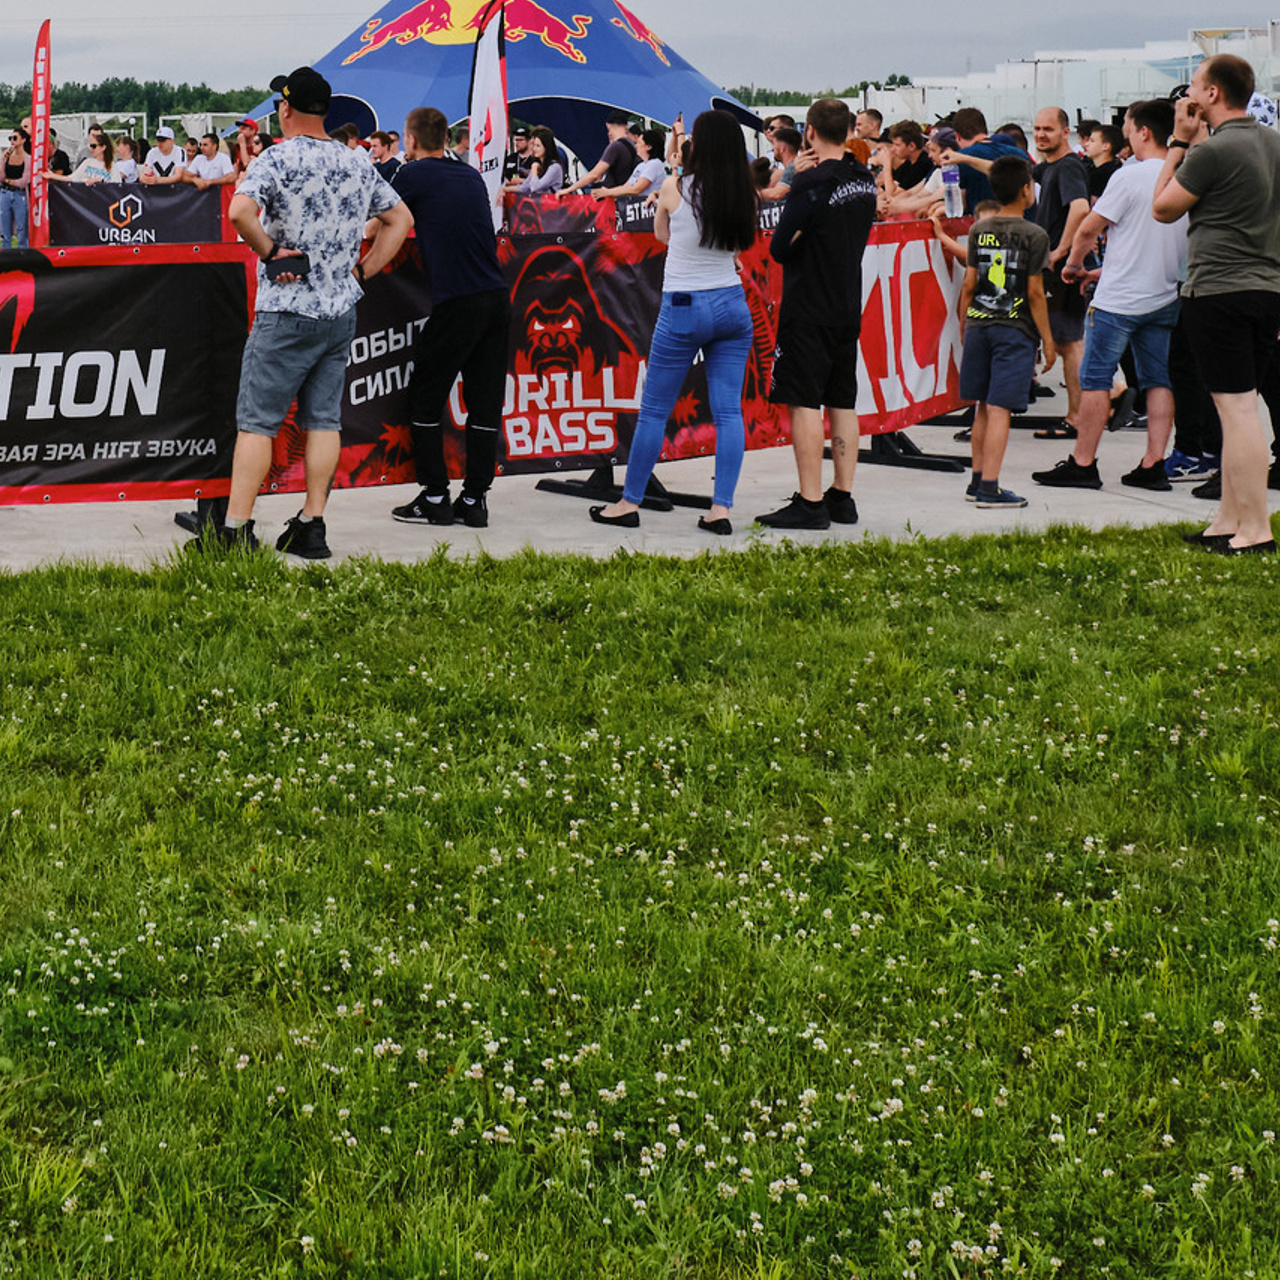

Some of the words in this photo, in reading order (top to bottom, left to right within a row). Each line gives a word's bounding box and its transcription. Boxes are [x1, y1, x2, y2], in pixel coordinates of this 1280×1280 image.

[99, 227, 156, 243] URBAN
[505, 411, 615, 456] BASS
[42, 442, 86, 461] ЭРА
[93, 440, 140, 459] HIFI
[145, 438, 218, 457] ЗВУКА
